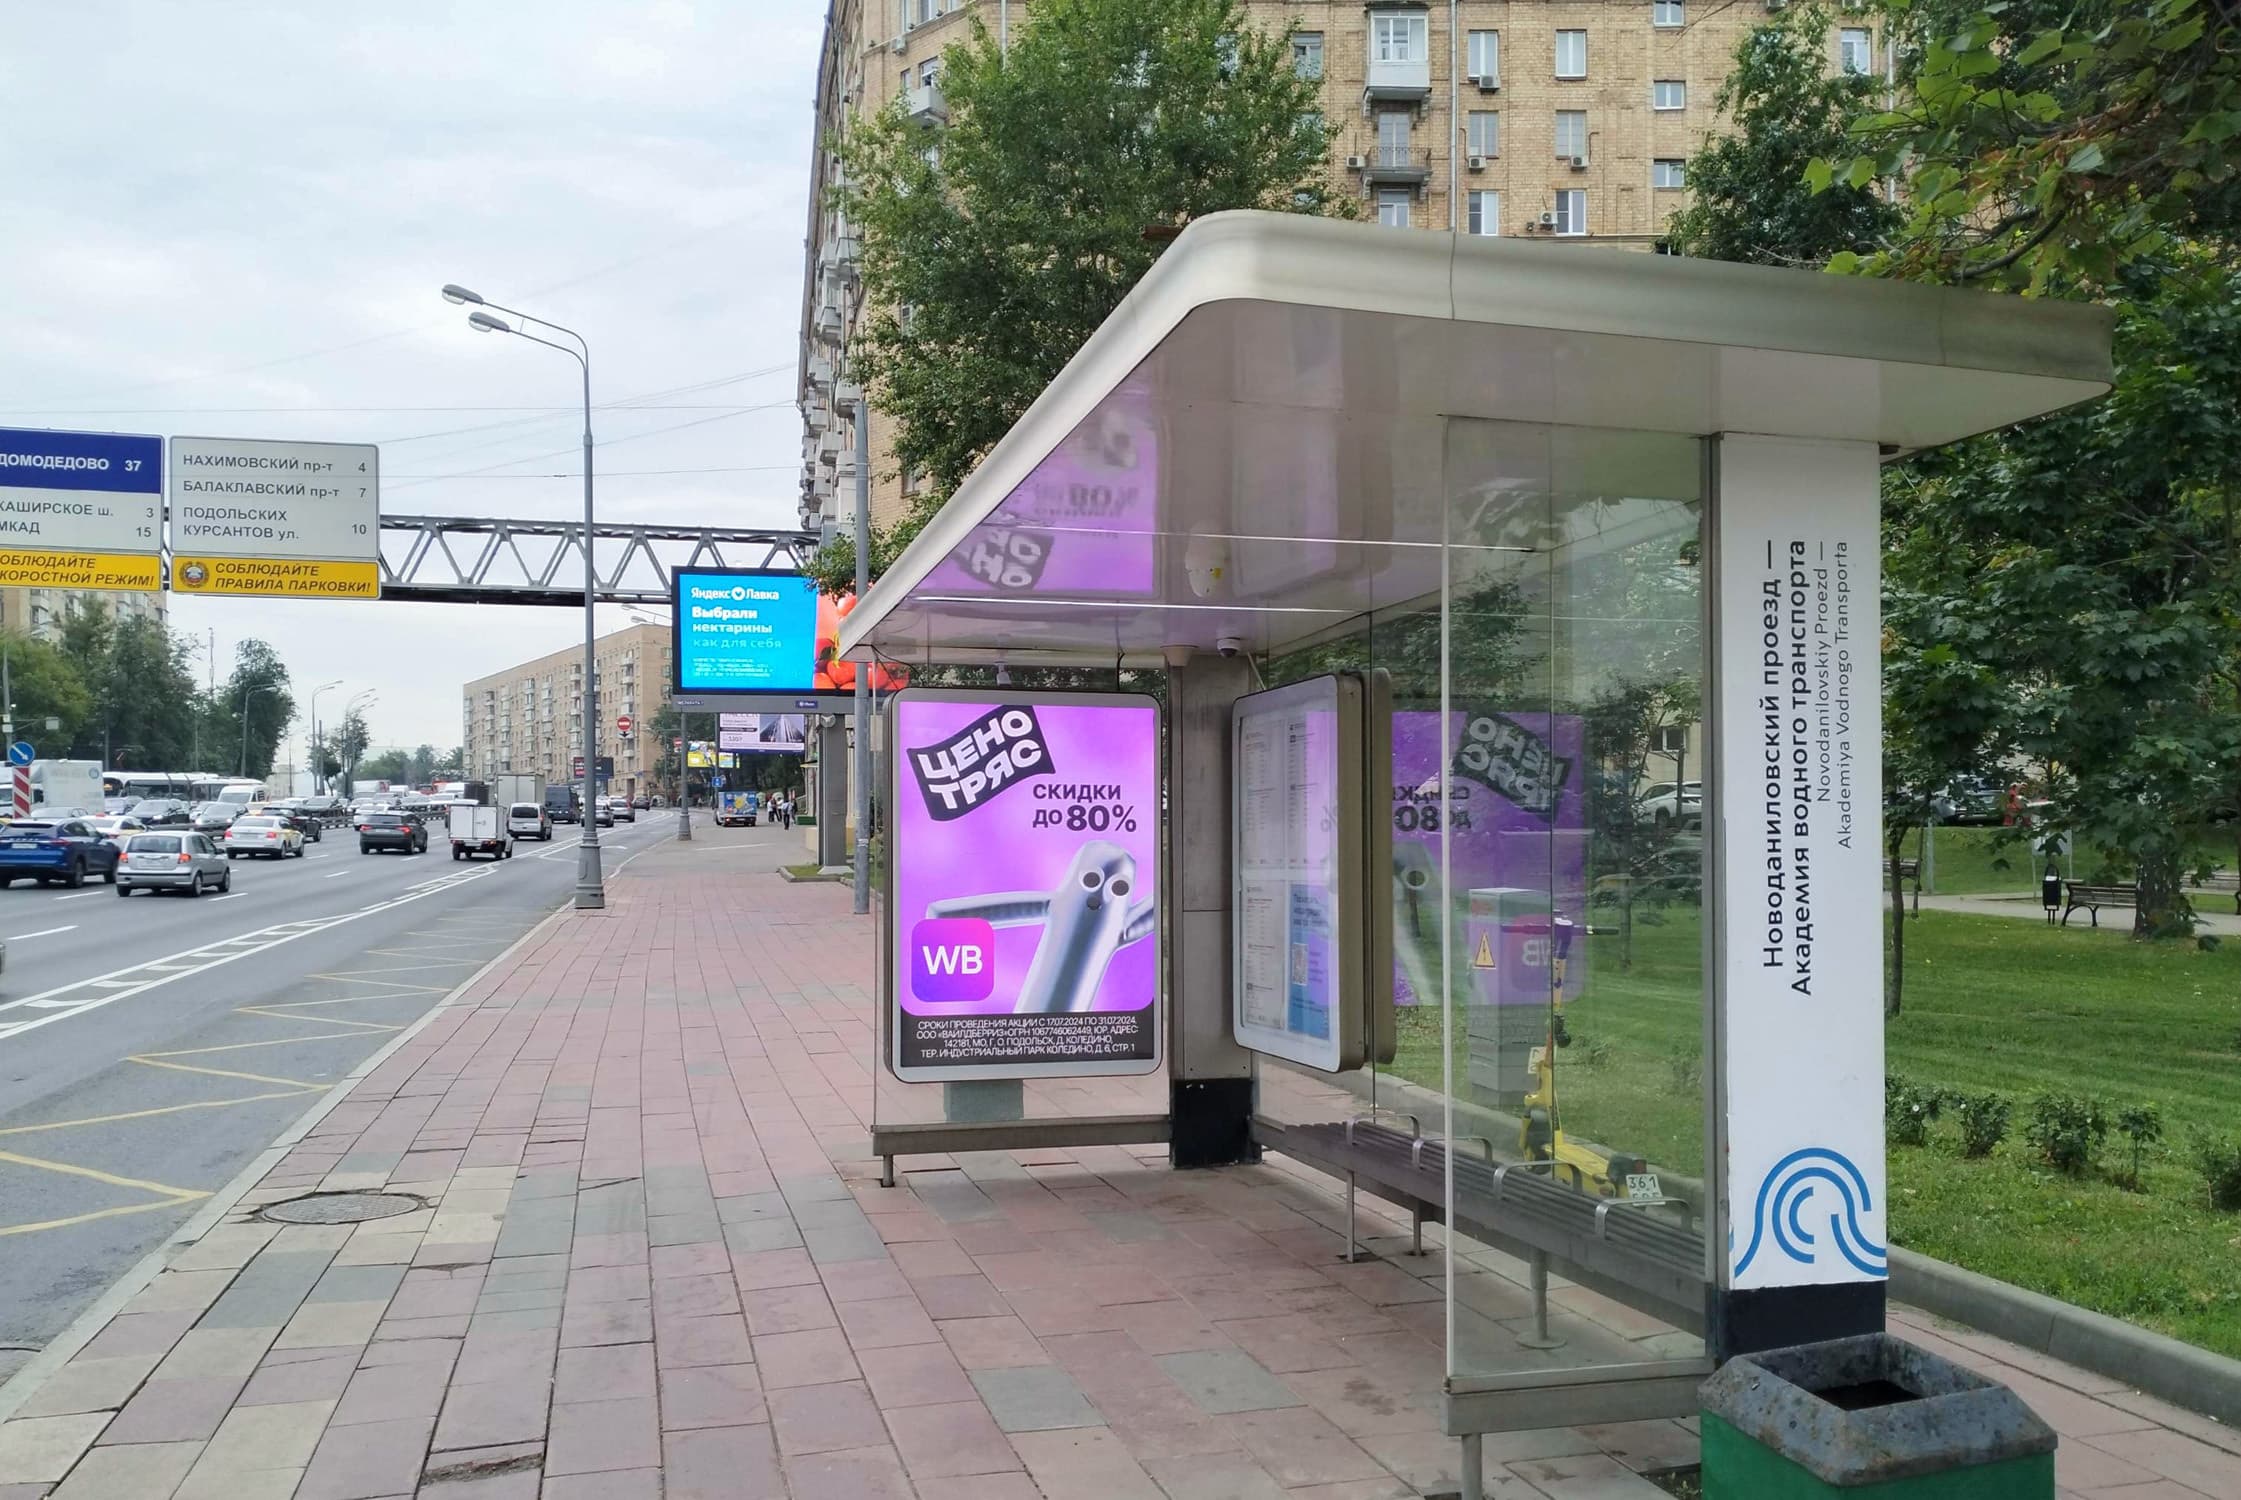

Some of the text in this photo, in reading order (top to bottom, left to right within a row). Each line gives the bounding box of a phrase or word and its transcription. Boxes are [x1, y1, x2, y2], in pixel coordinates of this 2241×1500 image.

[0, 454, 142, 471] ДОМОДЕДОВО 37
[183, 454, 366, 472] НАХИМОВСКИЙ пр-т 4
[183, 480, 366, 499] БАЛАКЛАВСКИЙ пр-т 7
[98, 508, 114, 516] ш.
[146, 508, 154, 518] 3
[183, 507, 287, 521] ПОДОЛЬСКИХ
[136, 527, 152, 537] 15
[183, 524, 367, 541] КУРСАНТОВ ул. 10
[215, 562, 320, 576] СОБЛЮДАЙТЕ
[95, 573, 154, 586] РЕЖИМ!
[215, 578, 371, 593] ПРАВИЛА ПАРКОВКИ!
[691, 587, 780, 600] Яндекс Лавка
[1813, 569, 1829, 634] Proezd
[691, 606, 758, 621] Выбрали
[692, 623, 773, 635] нектарины
[1763, 578, 1784, 685] проезд
[693, 637, 782, 649] как для себя
[1835, 541, 1852, 849] Akademiya Vodnogo Transporta
[1814, 640, 1832, 801] Novodanilovskiy
[917, 710, 1033, 780] ЦЕНО
[928, 738, 1042, 810] ТРЯС
[1790, 541, 1814, 996] Академия водного транспорта
[1066, 805, 1137, 832] 80%
[1760, 696, 1785, 967] Новоданиловский
[923, 945, 983, 975] WB
[918, 1021, 948, 1030] СРОКИ
[950, 1019, 1007, 1029] ПРОВЕДЕНИЯ
[1008, 1018, 1037, 1028] АКЦИИ
[1039, 1018, 1045, 1026] С
[1085, 1017, 1097, 1025] ПО
[917, 1030, 937, 1039] ООО
[1094, 1026, 1109, 1034] ЮР.
[940, 1047, 1022, 1058] ИНДУСТРИАЛЬНЫЙ
[1023, 1046, 1045, 1054] ПАРК
[1112, 1043, 1130, 1052] СТР.
[1628, 1176, 1657, 1189] 361
